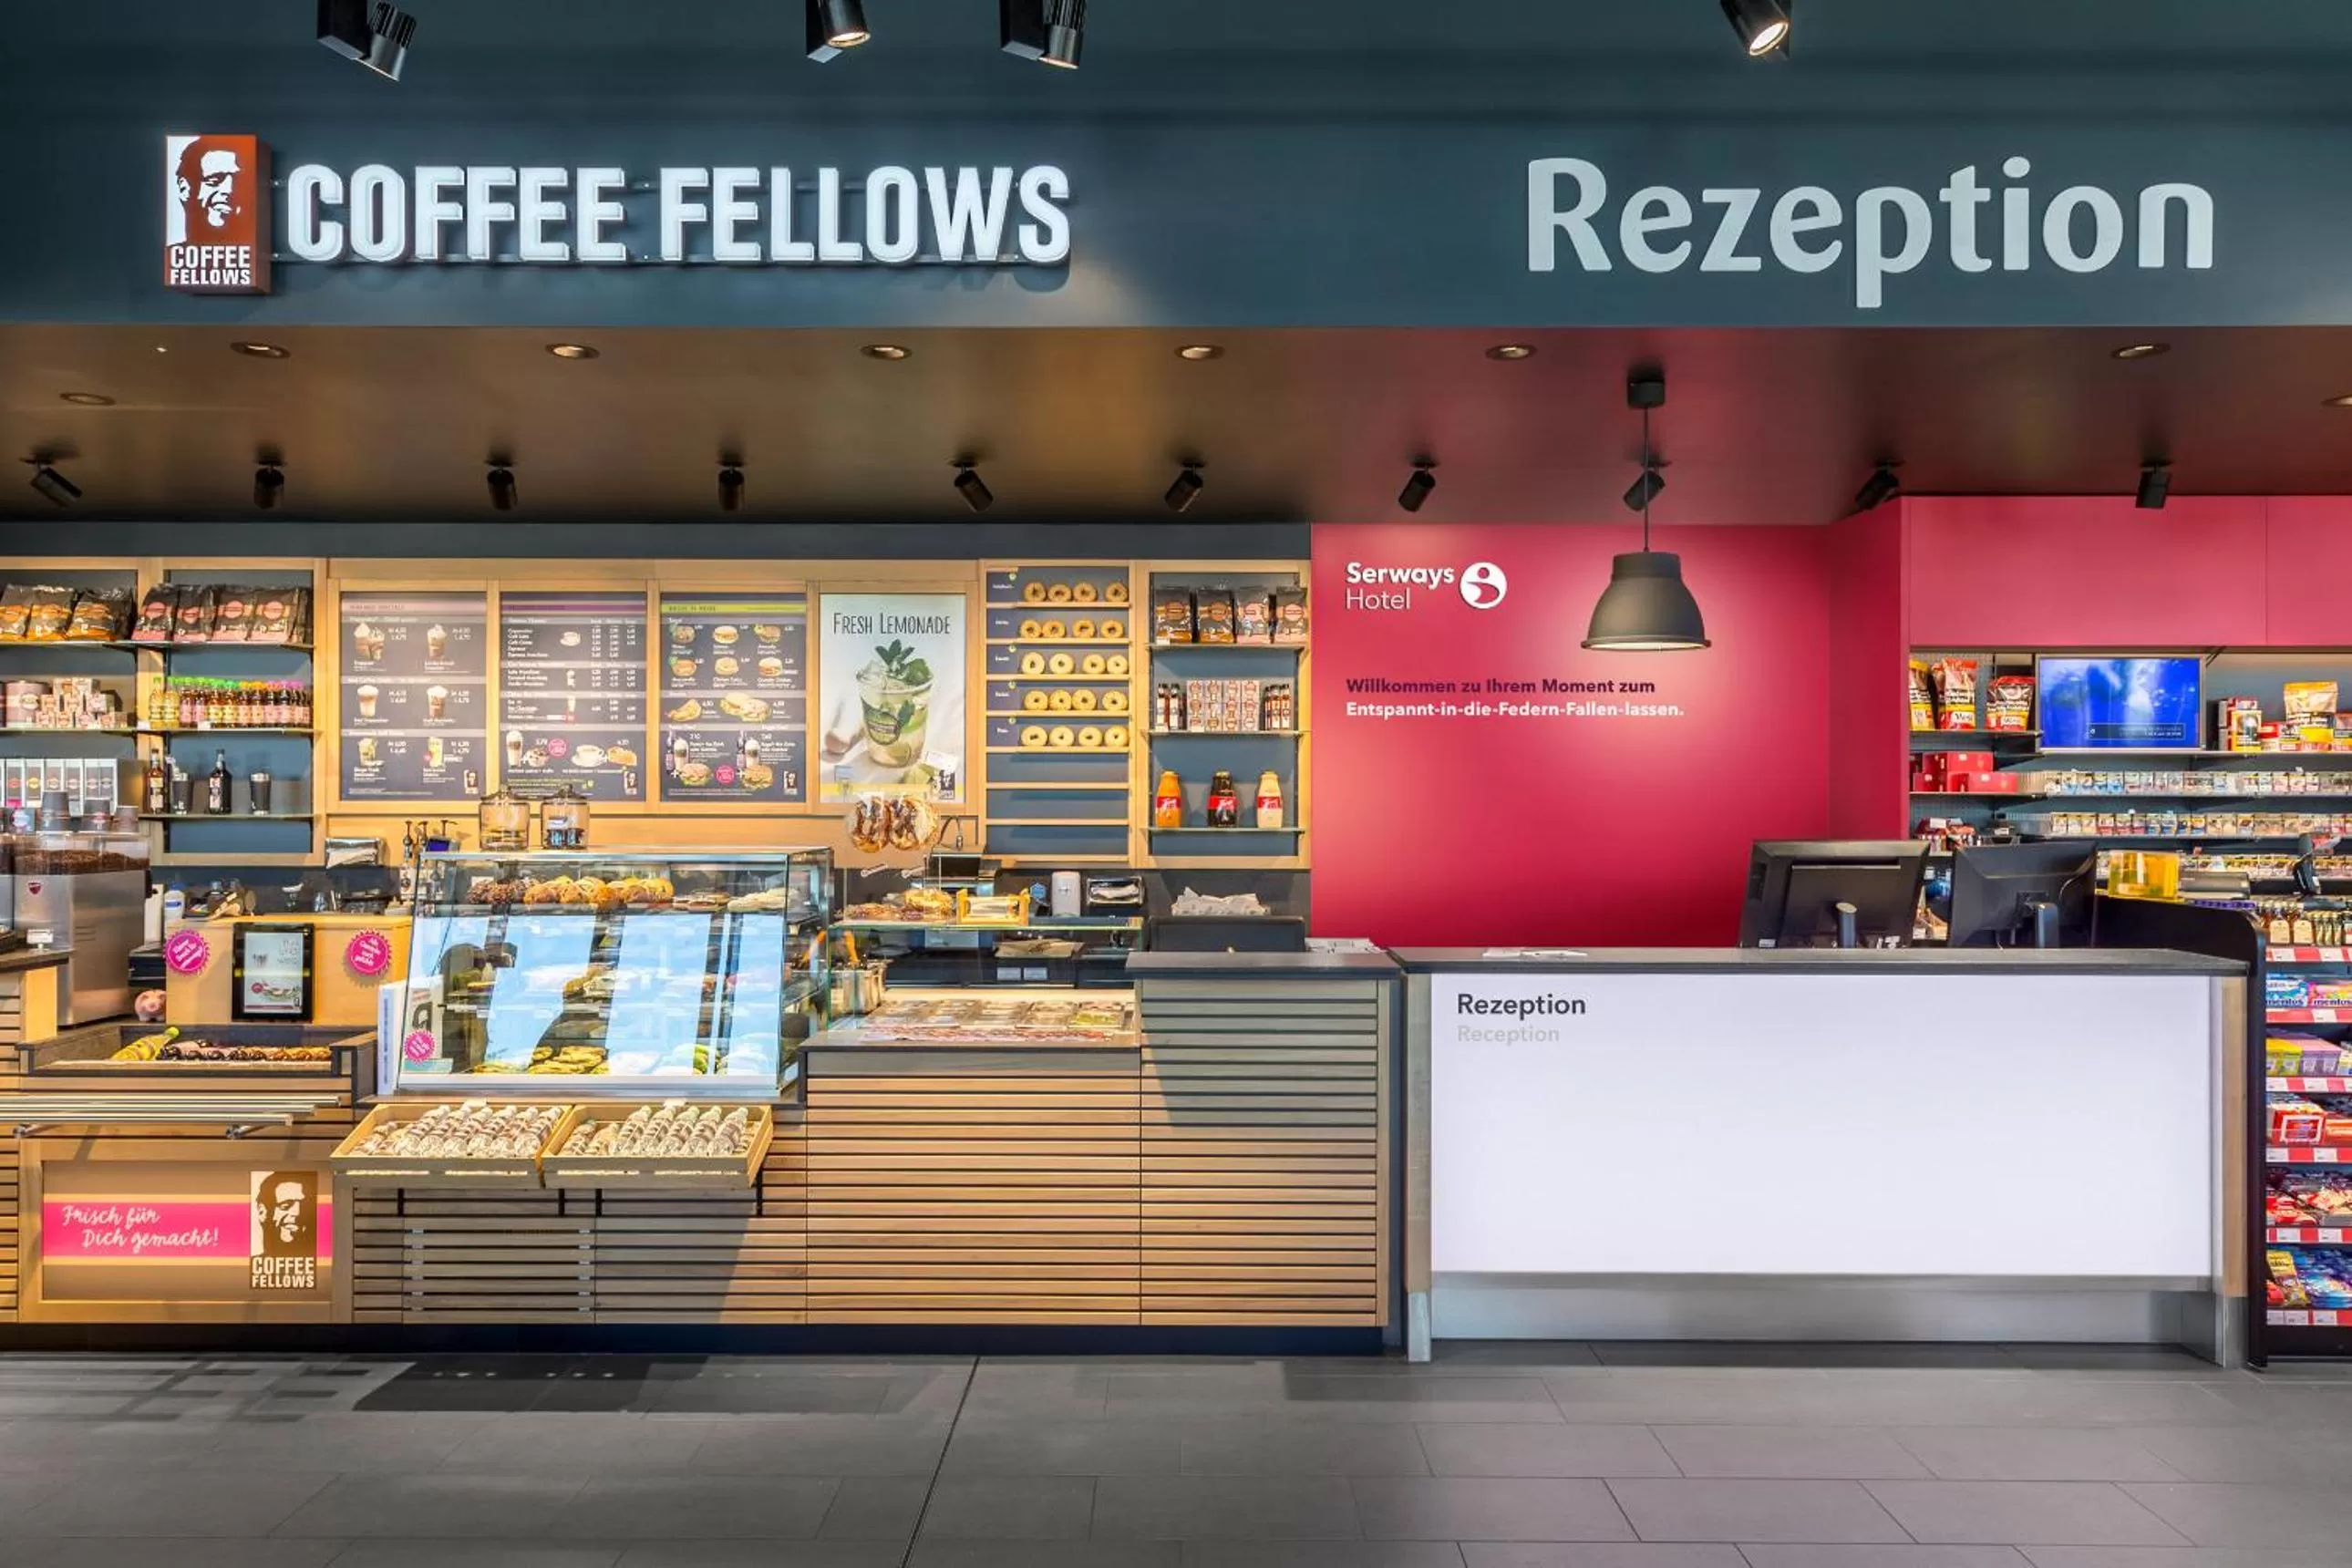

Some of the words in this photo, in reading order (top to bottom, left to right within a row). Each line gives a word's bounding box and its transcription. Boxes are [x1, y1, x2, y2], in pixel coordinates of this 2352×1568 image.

[286, 163, 627, 263] COFFEE
[659, 163, 1071, 264] FELLOWS
[1528, 157, 2213, 308] Rezeption
[170, 244, 252, 269] COFFEE
[170, 268, 252, 285] FELLOWS
[1346, 562, 1456, 591] Serways
[1346, 586, 1411, 610] Hotel
[832, 612, 873, 635] FRESH
[880, 612, 952, 635] LEMONADE
[1346, 678, 1456, 694] Willkommen
[1460, 680, 1482, 694] zu
[1486, 678, 1537, 694] Ihrem
[1542, 678, 1615, 694] Moment
[1618, 680, 1656, 694] zum
[1346, 701, 1685, 720] Entspannt-in-die-Federn-Fallen-lassen.
[1457, 993, 1586, 1021] Rezeption
[1457, 1025, 1561, 1047] Reception
[61, 1204, 123, 1226] Frisch
[124, 1206, 161, 1231] für
[82, 1228, 128, 1249] Dich
[130, 1228, 220, 1254] gemacht!
[252, 1256, 315, 1275] COFFEE
[252, 1274, 315, 1288] FELLOWS
